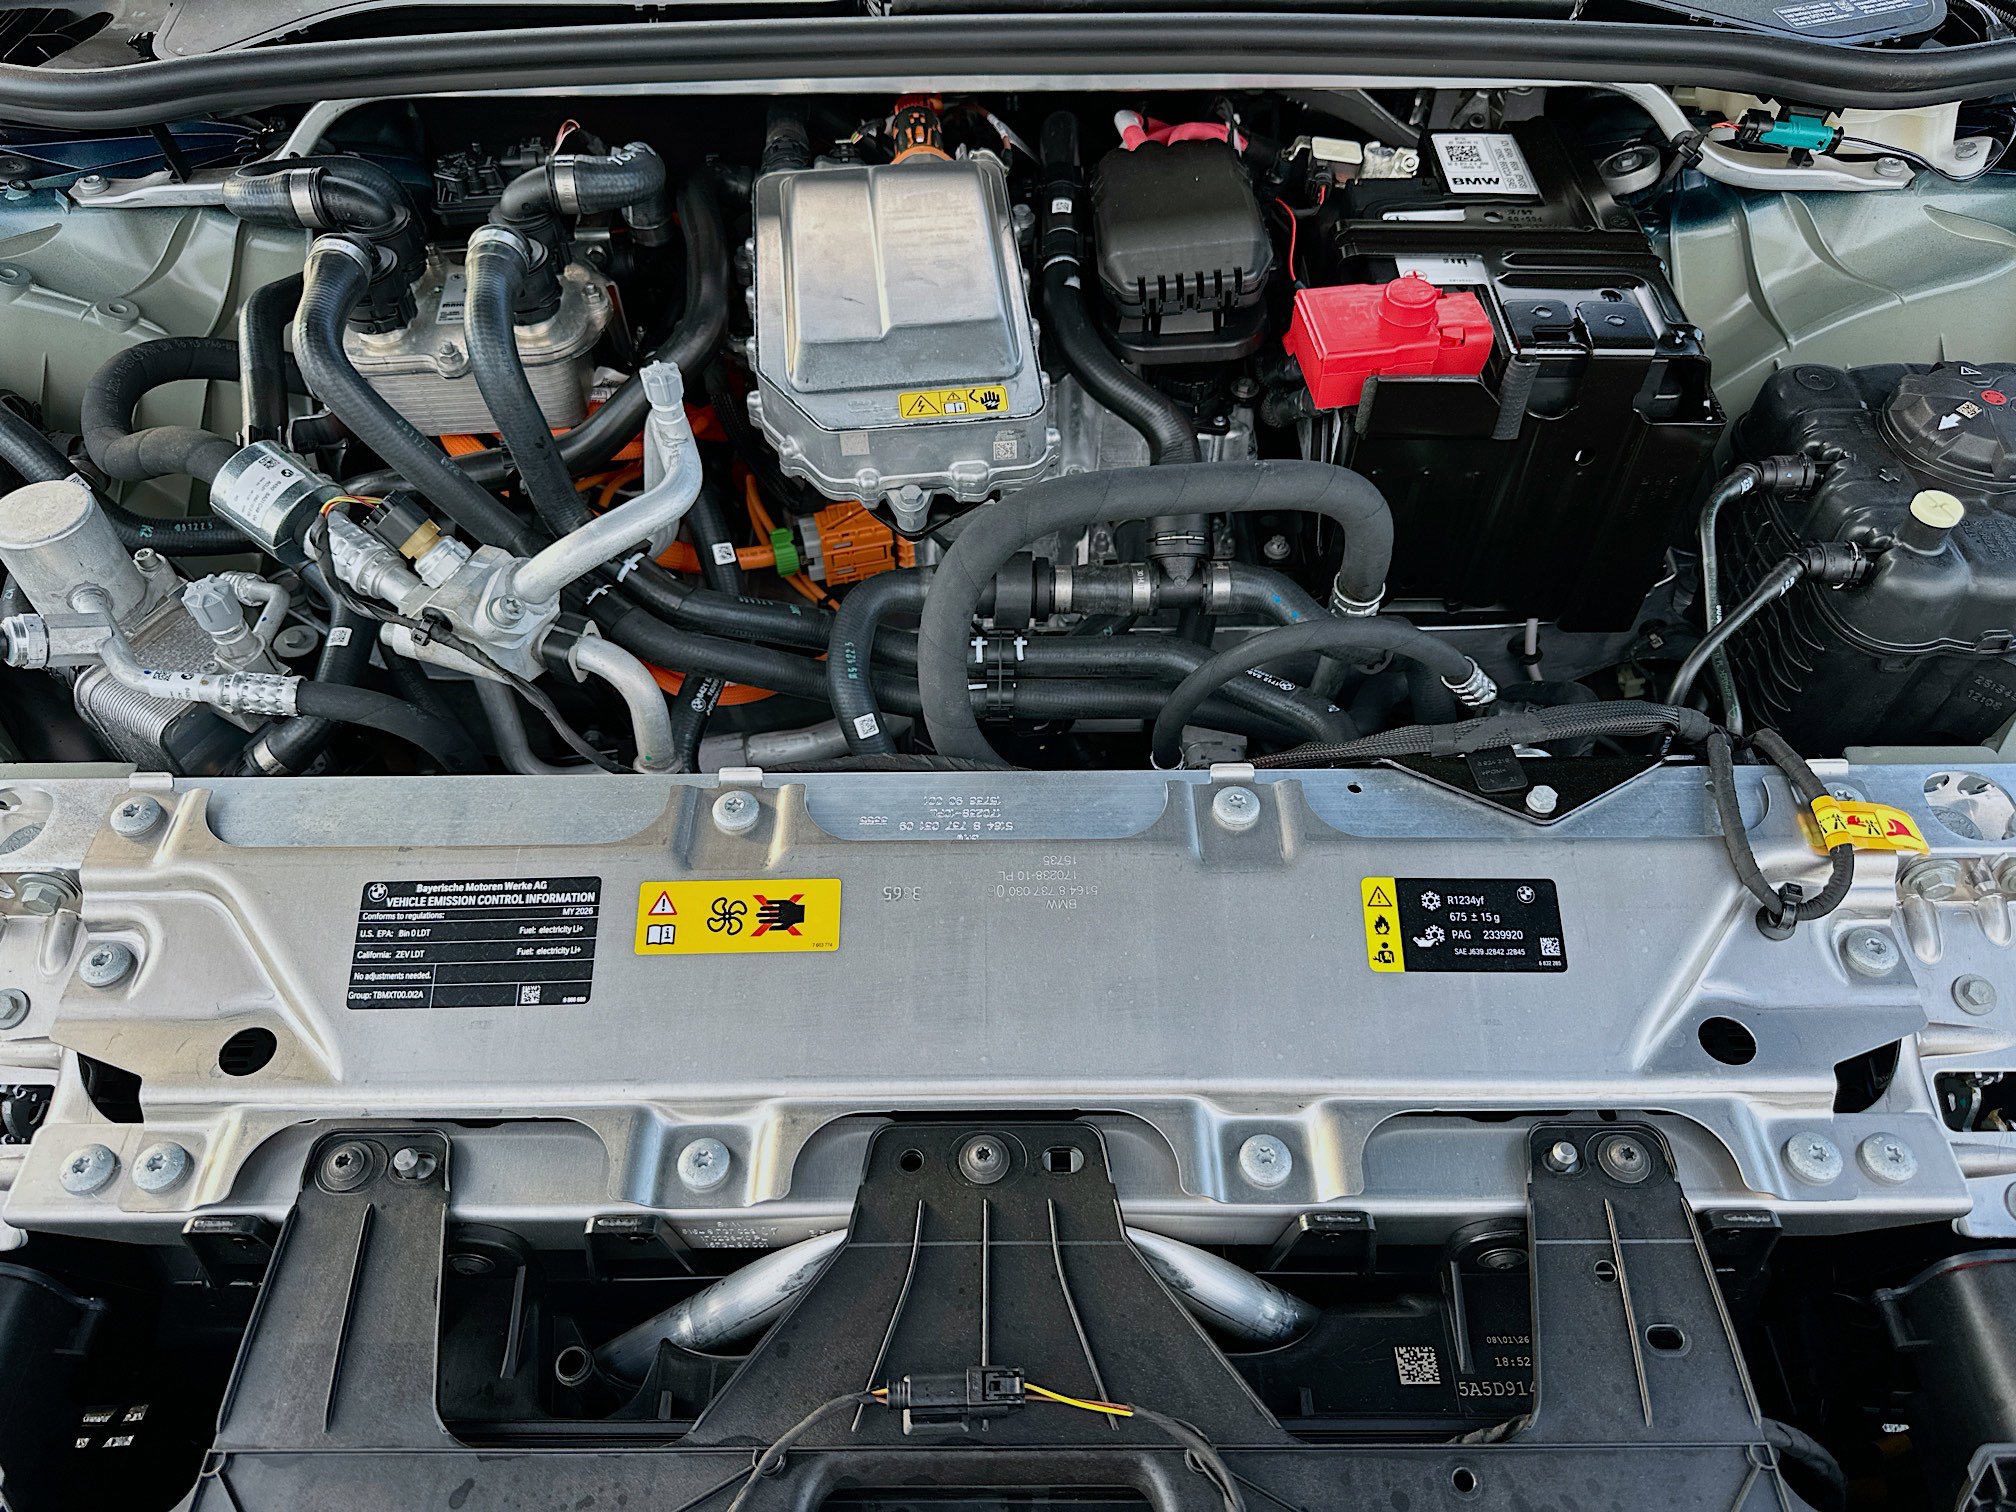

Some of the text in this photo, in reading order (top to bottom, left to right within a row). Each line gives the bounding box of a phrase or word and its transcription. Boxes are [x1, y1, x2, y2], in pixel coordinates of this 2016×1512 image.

[1451, 177, 1500, 186] BMW
[1042, 855, 1078, 866] 15735
[997, 870, 1078, 881] 170238-10 PL
[416, 880, 548, 895] Bayerische Motoren Werke AG
[1009, 886, 1031, 896] 030
[1033, 885, 1056, 896] 737
[1058, 885, 1066, 895] 8
[1069, 885, 1098, 896] 5164
[386, 892, 596, 908] VEHICLE EMISSION CONTROL INFORMATION
[1045, 898, 1078, 909] BMW
[1447, 895, 1485, 906] R1234yf
[362, 912, 445, 921] Conforms to regulations:
[562, 907, 594, 916] MY 2026
[1449, 912, 1501, 924] 675 ± 15 g
[359, 929, 394, 938] U.S. EPA:
[398, 929, 411, 937] Bin
[416, 928, 432, 937] LDT
[518, 924, 584, 935] Fuel: electricity Li+
[1451, 929, 1524, 940] PAG 2339920
[356, 950, 426, 959] California: ZEV LDT
[516, 945, 582, 956] Fuel: electricity Li+
[1454, 948, 1526, 956] SAE J639 J2842 J2845
[353, 971, 432, 982] No adjustments needed.
[348, 991, 372, 1001] Group:
[1494, 1356, 1532, 1367] 18:52
